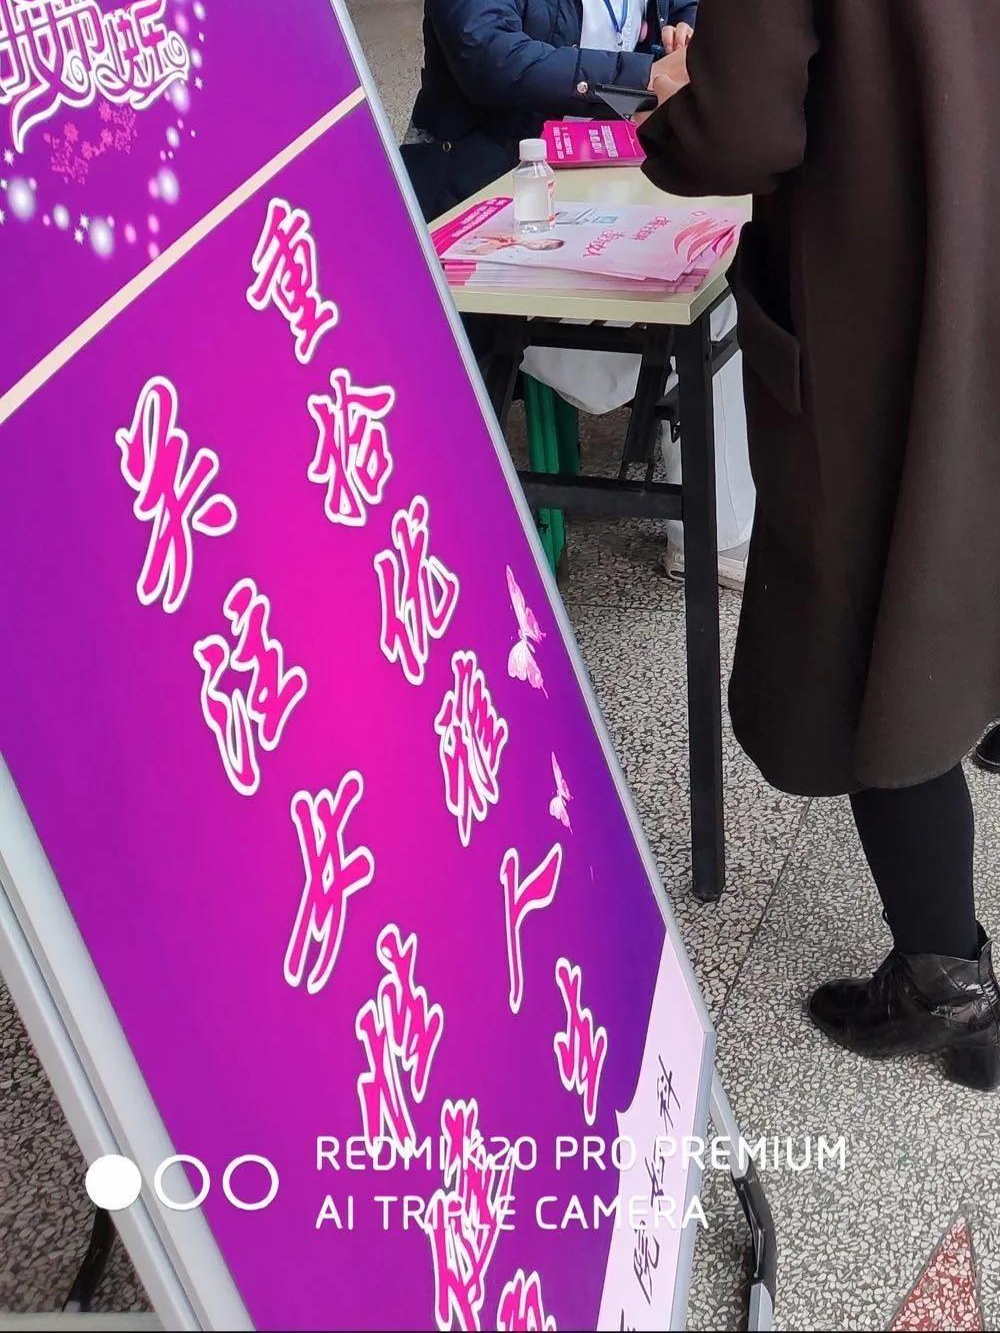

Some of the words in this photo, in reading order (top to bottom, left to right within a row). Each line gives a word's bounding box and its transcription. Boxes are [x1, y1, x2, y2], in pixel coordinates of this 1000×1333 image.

[246, 197, 606, 1126] 重拾优雅人生
